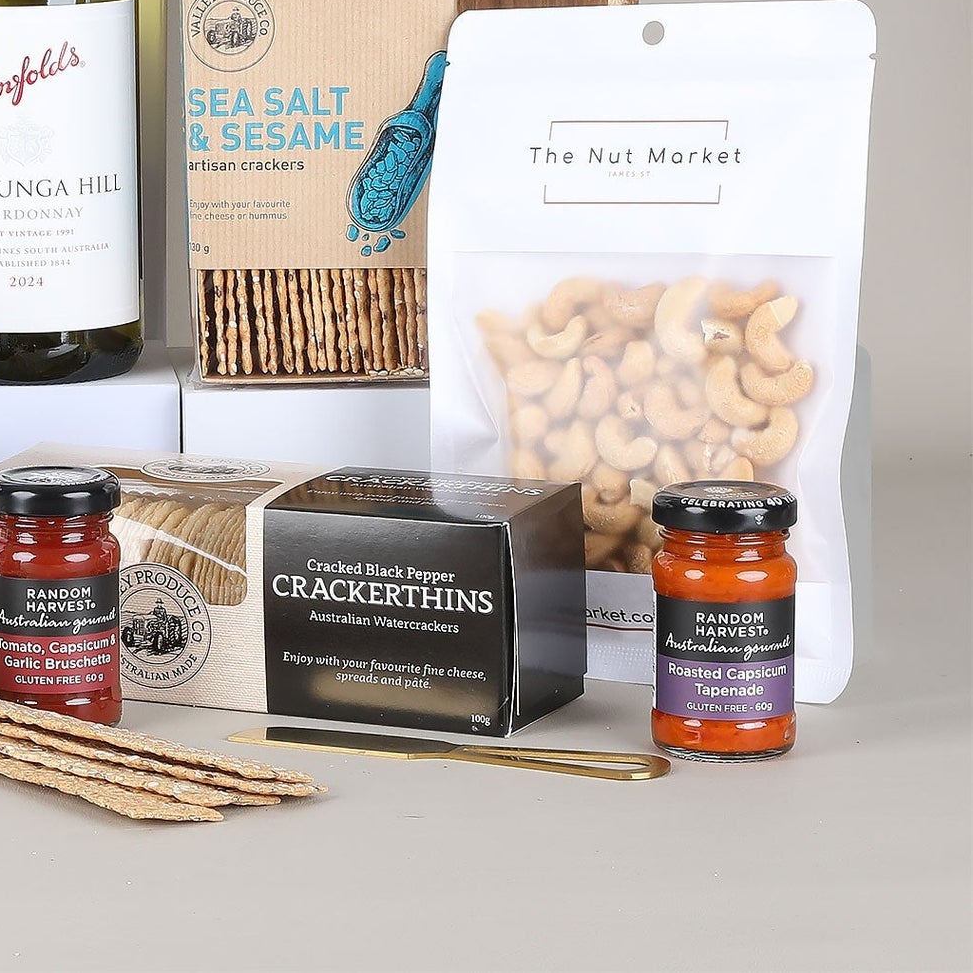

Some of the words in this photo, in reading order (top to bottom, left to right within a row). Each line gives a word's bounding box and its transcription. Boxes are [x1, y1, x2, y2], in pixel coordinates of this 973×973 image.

[188, 86, 254, 117] SEA
[263, 86, 350, 117] SALT
[188, 123, 210, 152] &
[221, 121, 365, 152] SESAME
[529, 147, 574, 164] The
[588, 147, 633, 164] Nut
[648, 147, 741, 164] Market
[188, 158, 236, 172] artisan
[240, 158, 305, 171] crackers
[79, 173, 121, 195] HILL
[211, 200, 230, 209] with
[231, 201, 250, 210] your
[253, 200, 291, 208] favourite
[204, 212, 235, 220] cheese
[237, 212, 247, 220] or
[249, 211, 288, 220] hummus
[9, 229, 52, 237] VINTAGE
[24, 247, 58, 255] SOUTH
[61, 243, 109, 253] AUSTRALIA
[203, 245, 210, 254] g
[10, 276, 44, 287] 2024
[680, 497, 764, 508] CELEBRATING
[306, 558, 363, 575] Cracked
[365, 563, 404, 580] Black
[406, 566, 456, 585] Pepper
[27, 586, 91, 600] RANDOM
[134, 570, 202, 617] PRODUCE
[272, 574, 494, 615] CRACKERTHINS
[72, 607, 116, 635] gourmet
[309, 610, 371, 627] Australian
[373, 615, 460, 634] Watercrackers
[696, 612, 764, 624] RANDOM
[49, 639, 109, 655] Capsicum
[665, 632, 742, 654] Australian
[743, 634, 791, 661] gourmet
[4, 654, 41, 670] Garlic
[45, 653, 111, 670] Bruschetta
[172, 653, 198, 678] MADE
[282, 651, 314, 666] Enjoy
[315, 655, 341, 667] with
[342, 657, 368, 673] your
[368, 658, 422, 677] favourite
[423, 663, 445, 679] fine
[446, 666, 487, 682] cheese,
[14, 675, 54, 685] GLUTEN
[56, 675, 81, 685] FREE
[668, 662, 722, 680] Roasted
[726, 664, 787, 682] Capsicum
[335, 671, 378, 687] spreads
[380, 674, 402, 686] and
[403, 675, 432, 690] pâté.
[694, 684, 764, 698] Tapenade
[687, 702, 722, 713] GLUTEN
[724, 703, 748, 713] FREE
[471, 714, 491, 727] 100g
